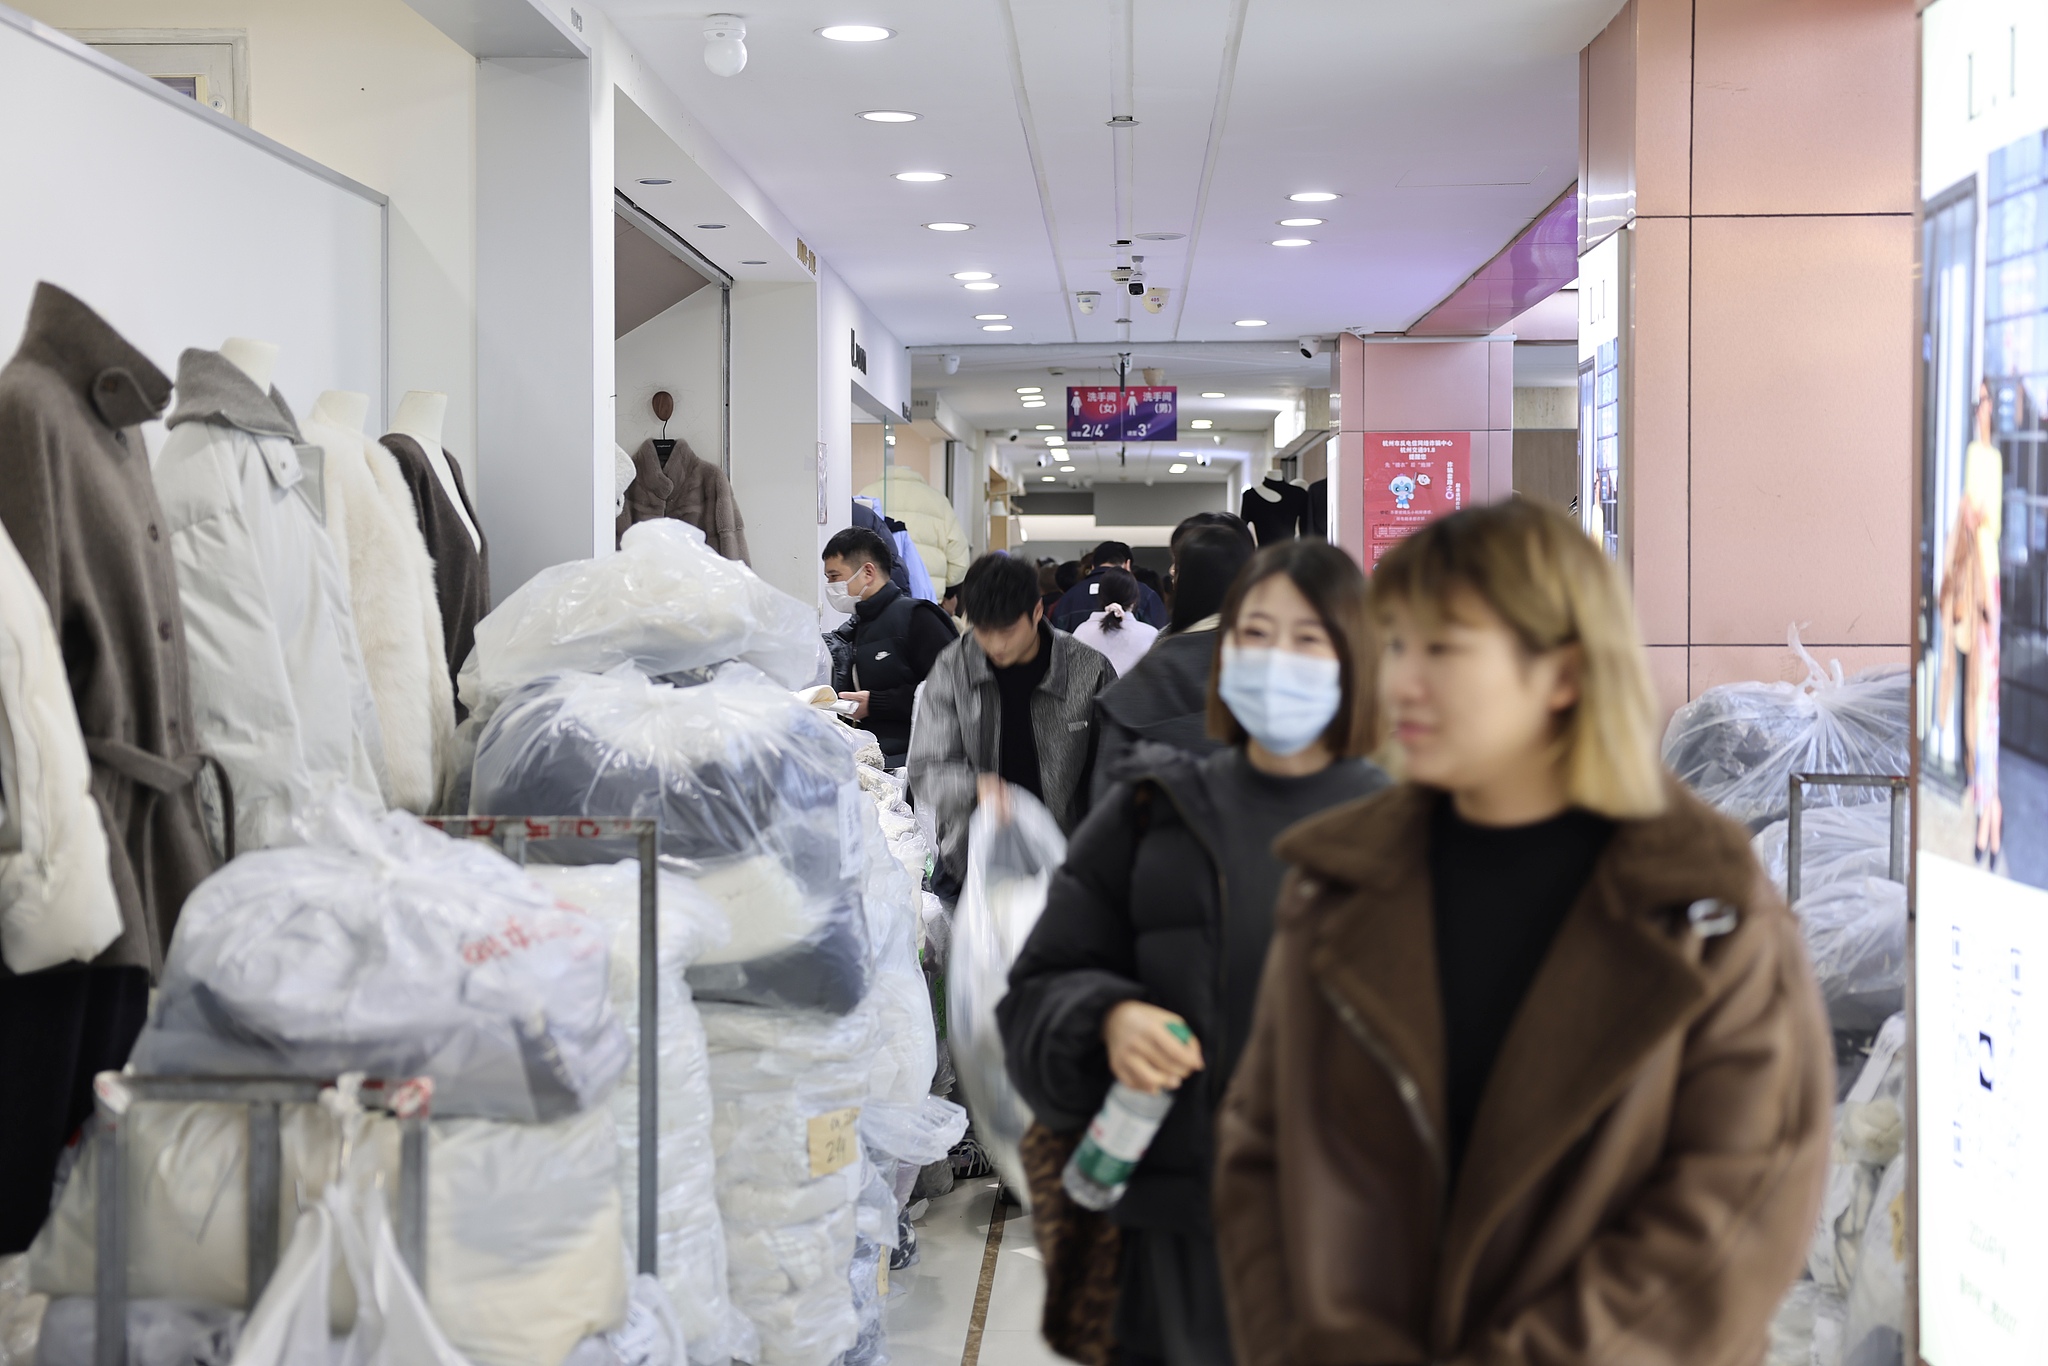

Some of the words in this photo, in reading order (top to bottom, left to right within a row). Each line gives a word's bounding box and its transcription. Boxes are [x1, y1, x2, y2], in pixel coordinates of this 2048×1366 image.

[1087, 391, 1117, 402] 洗手间
[1142, 391, 1172, 402] 洗手间
[1098, 403, 1117, 414] (女)
[1154, 403, 1172, 414] (男)
